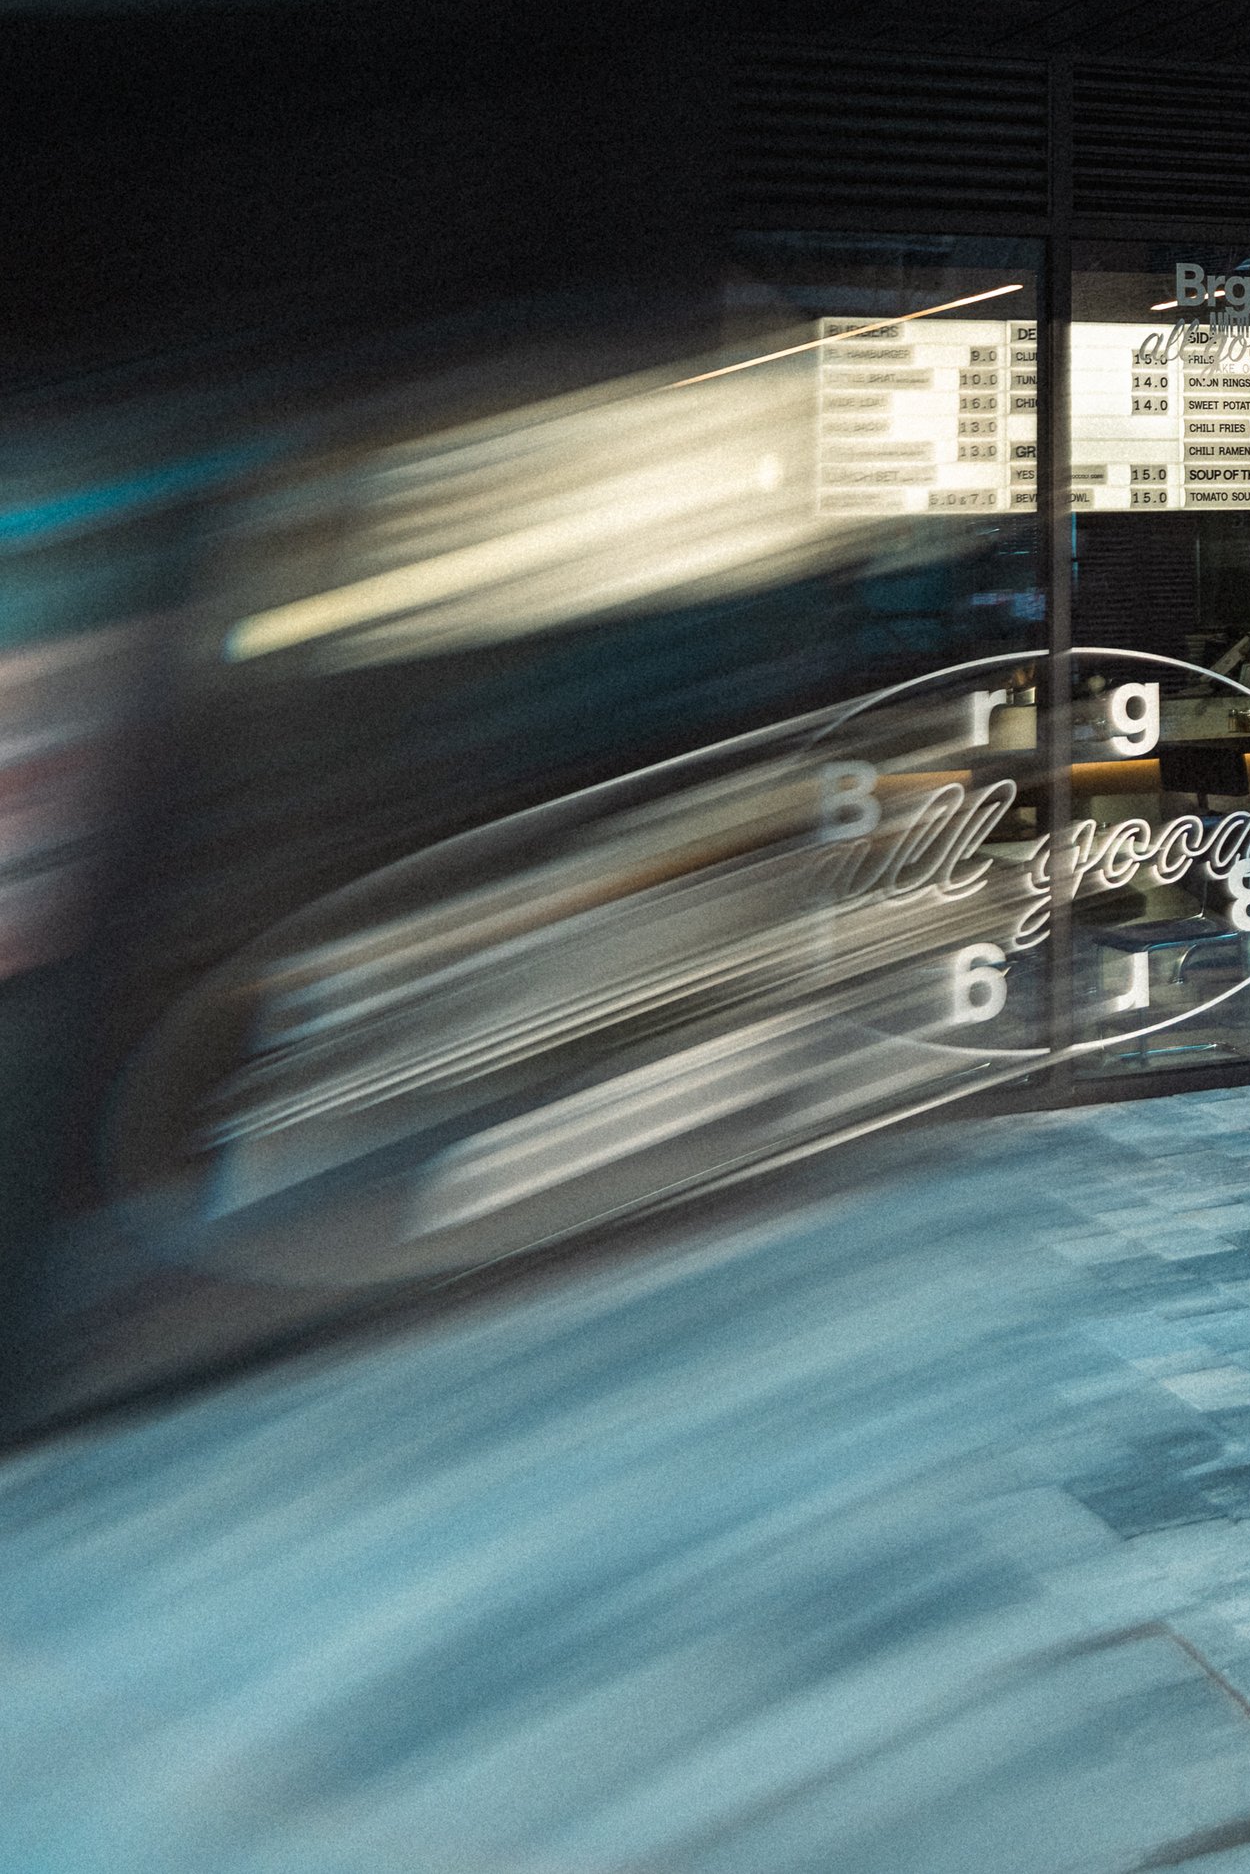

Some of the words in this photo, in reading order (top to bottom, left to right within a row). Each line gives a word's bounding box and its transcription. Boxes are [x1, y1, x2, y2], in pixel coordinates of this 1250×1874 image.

[970, 350, 998, 361] 9.0
[1015, 351, 1038, 361] CLU
[961, 374, 998, 385] 10.0
[1016, 375, 1038, 384] TUN
[1133, 377, 1168, 388] 14.0
[1188, 378, 1219, 388] ONON
[1222, 378, 1250, 388] RINGS
[961, 397, 998, 409] 16.0
[1133, 400, 1168, 411] 14.0
[1188, 400, 1219, 410] SWEET
[960, 421, 998, 433] 13.0
[1189, 423, 1215, 433] CHILI
[1219, 424, 1246, 433] FRIES
[960, 445, 998, 457] 13.0
[1189, 446, 1215, 456] CHILI
[1219, 446, 1250, 456] RAMEN
[1016, 470, 1035, 479] YES
[1133, 469, 1167, 480] 15.0
[1189, 470, 1221, 481] SOUP
[1223, 470, 1239, 480] OF
[1133, 492, 1167, 503] 15.0
[1190, 492, 1228, 502] TOMATO
